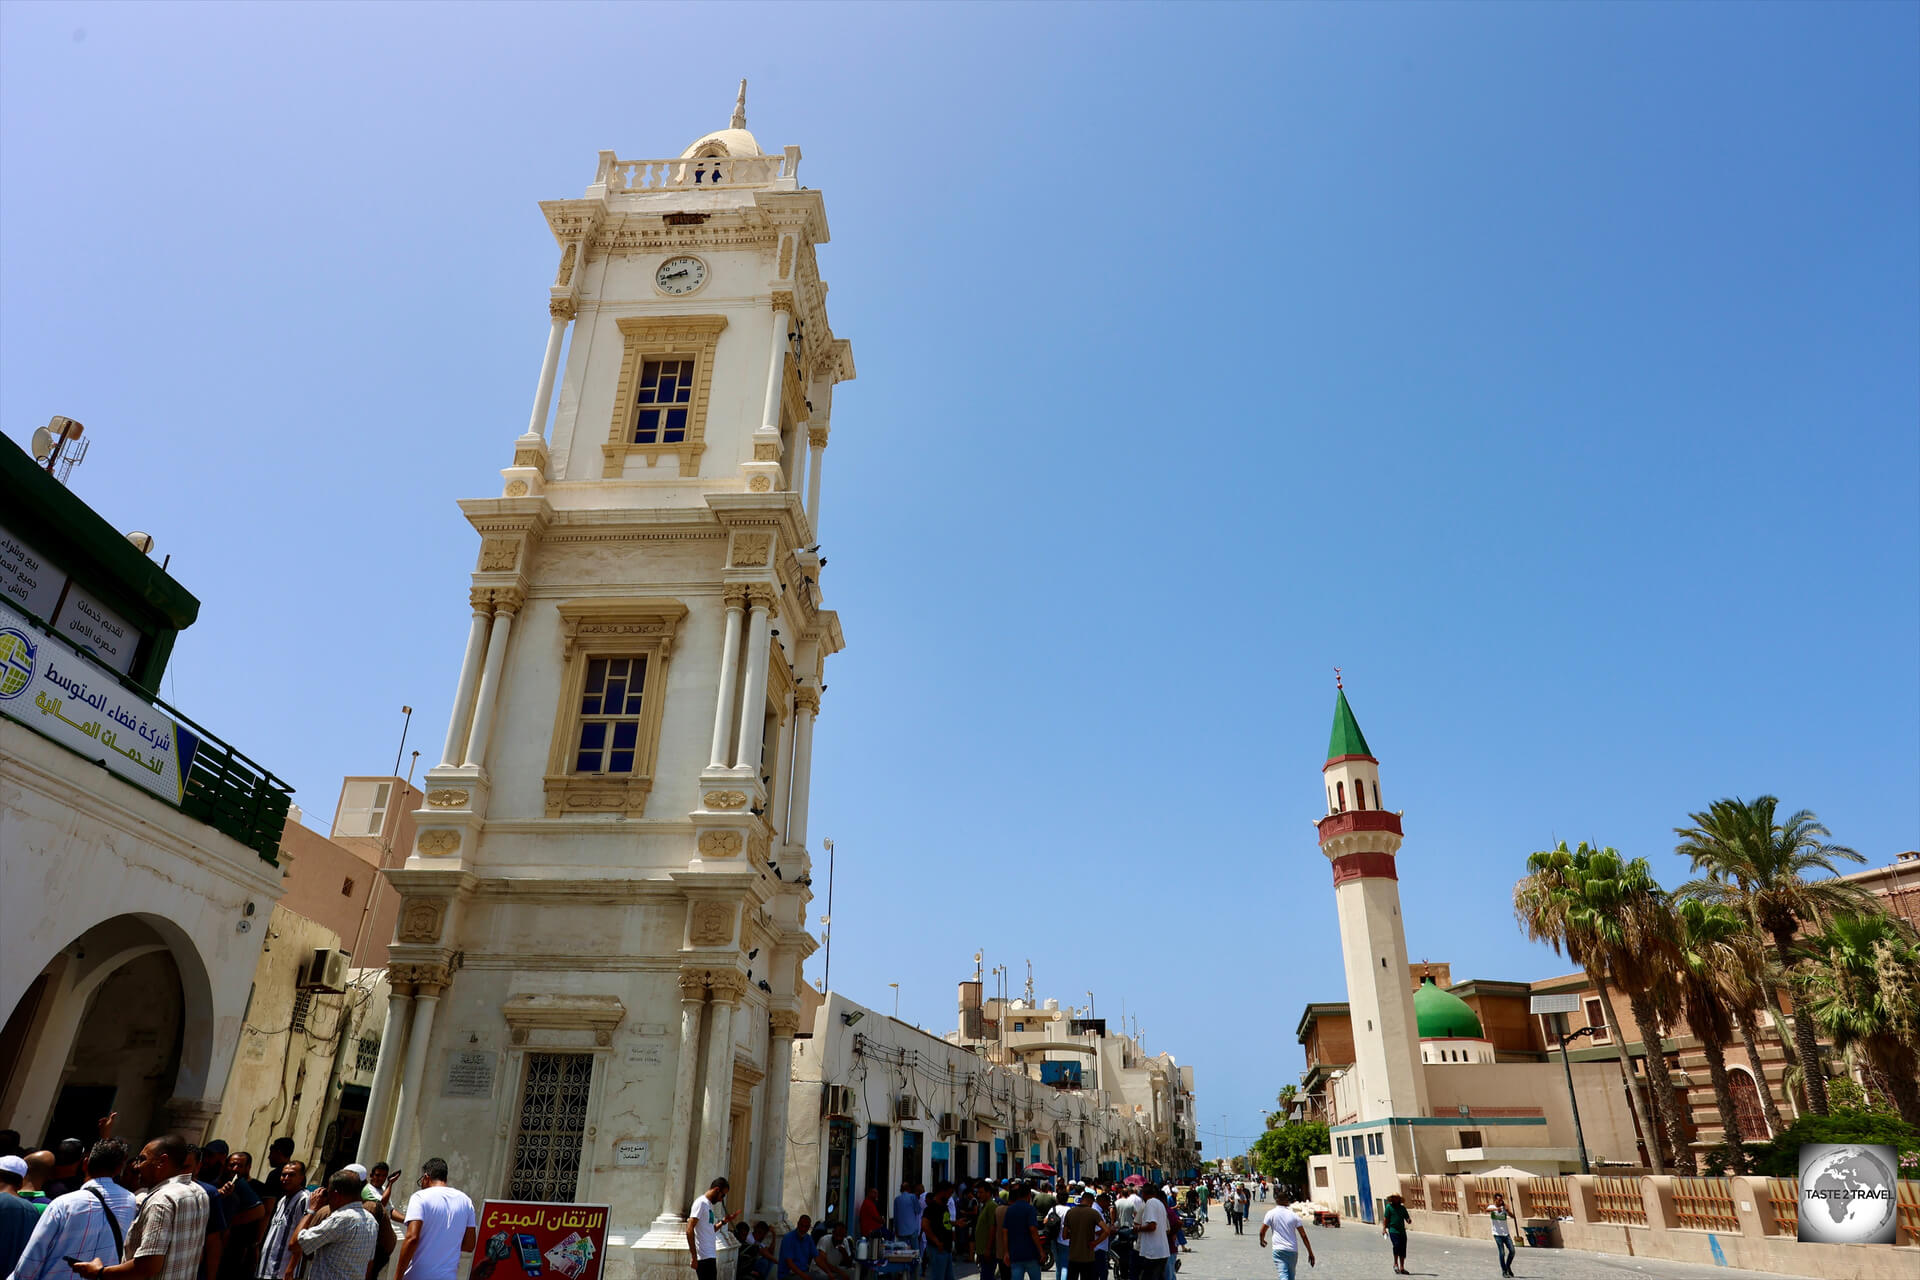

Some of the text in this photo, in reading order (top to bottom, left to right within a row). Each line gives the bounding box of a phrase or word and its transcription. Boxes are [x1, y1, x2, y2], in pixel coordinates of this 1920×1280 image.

[1, 539, 40, 573] بيع وشراء
[17, 572, 37, 590] جميع
[78, 600, 124, 640] تقديم خدمات
[94, 634, 117, 656] مصرف
[35, 690, 100, 740] المالية
[44, 662, 170, 752] شركة فضاء المتوسط
[486, 1210, 604, 1233] الإتقان المبدع
